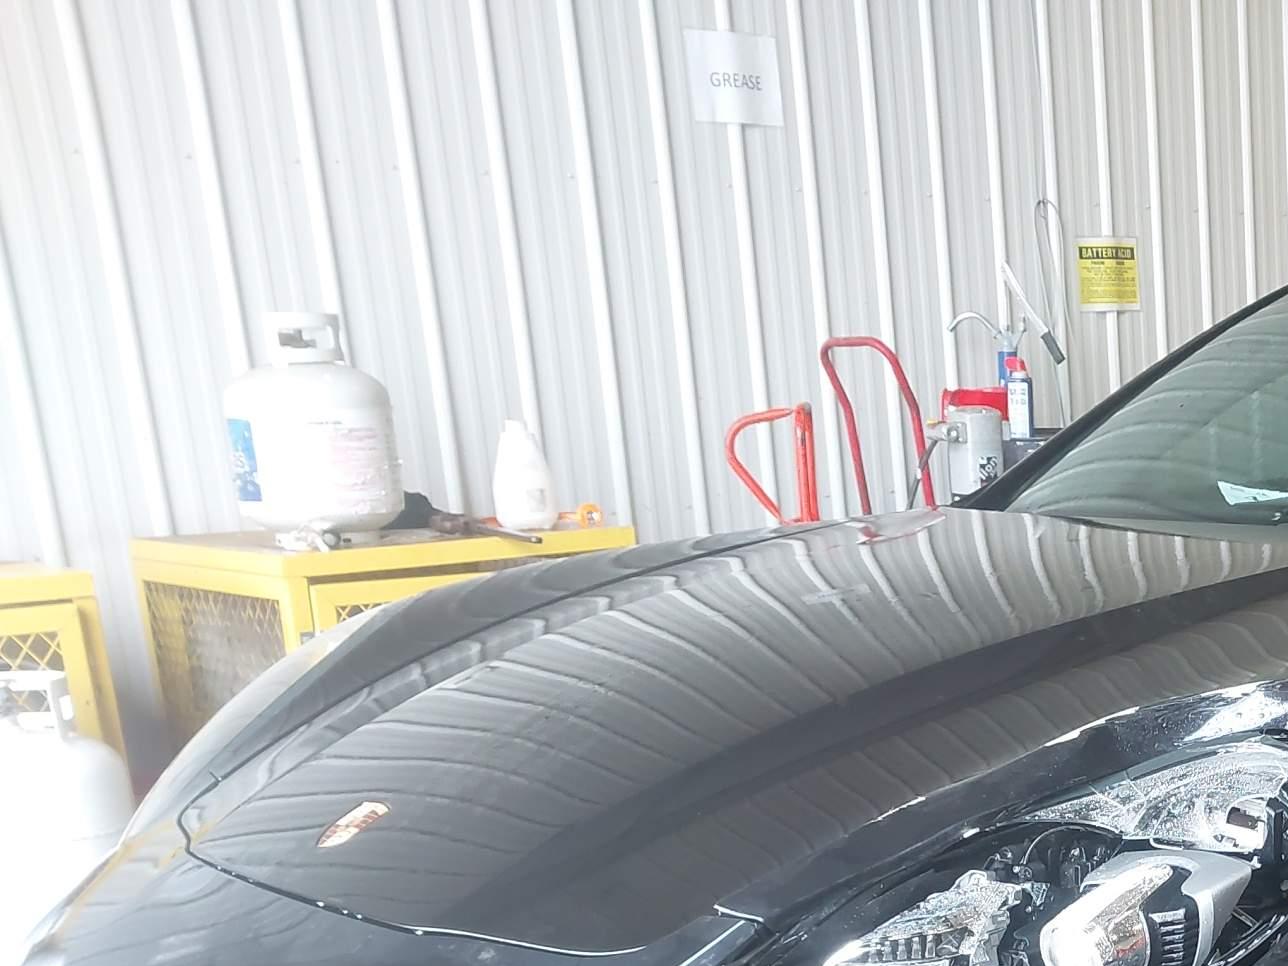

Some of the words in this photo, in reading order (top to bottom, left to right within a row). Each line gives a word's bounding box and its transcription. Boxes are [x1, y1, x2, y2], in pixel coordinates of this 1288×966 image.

[710, 72, 763, 91] GREASE
[1081, 247, 1117, 258] BATTERY
[1118, 247, 1132, 259] ACID
